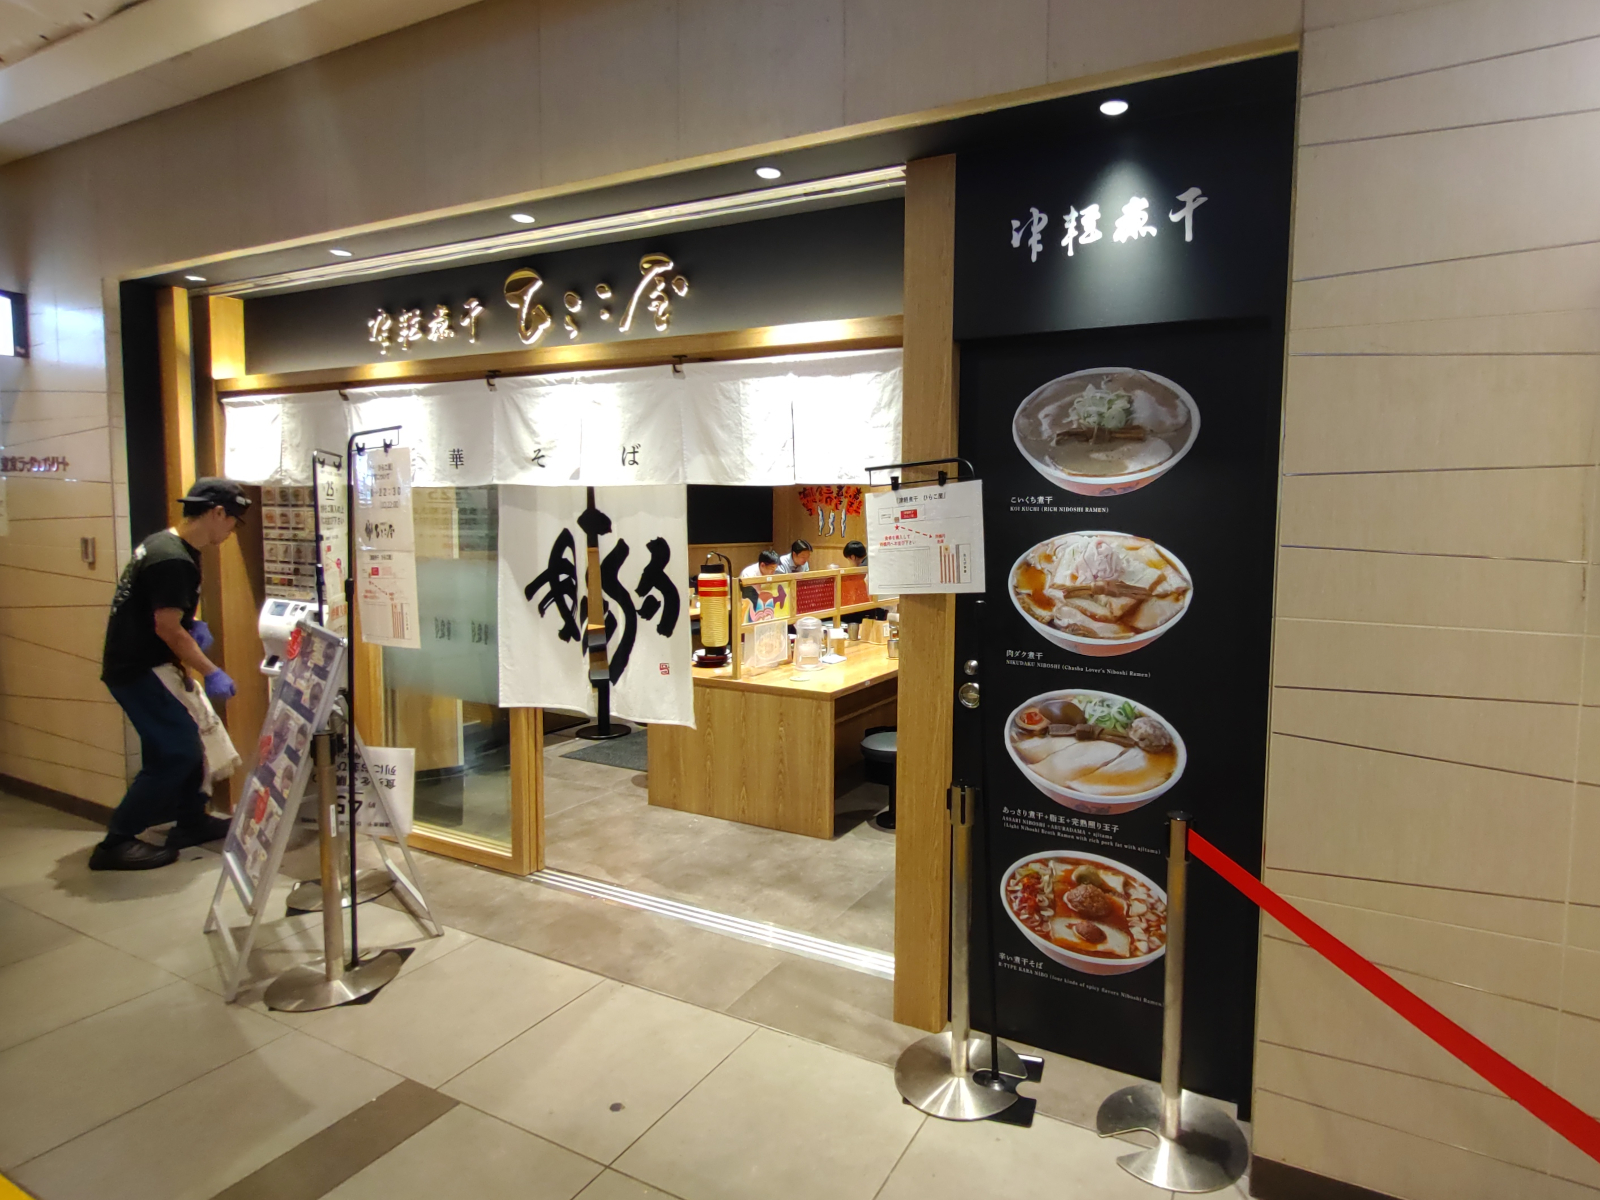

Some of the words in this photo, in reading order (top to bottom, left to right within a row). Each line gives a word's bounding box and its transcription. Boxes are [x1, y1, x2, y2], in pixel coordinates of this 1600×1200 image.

[1010, 186, 1209, 263] 津軽煮干
[1010, 495, 1053, 505] こいくち煮干
[1006, 649, 1044, 660] 肉ダク煮干
[999, 952, 1044, 969] 辛い煮干そば
